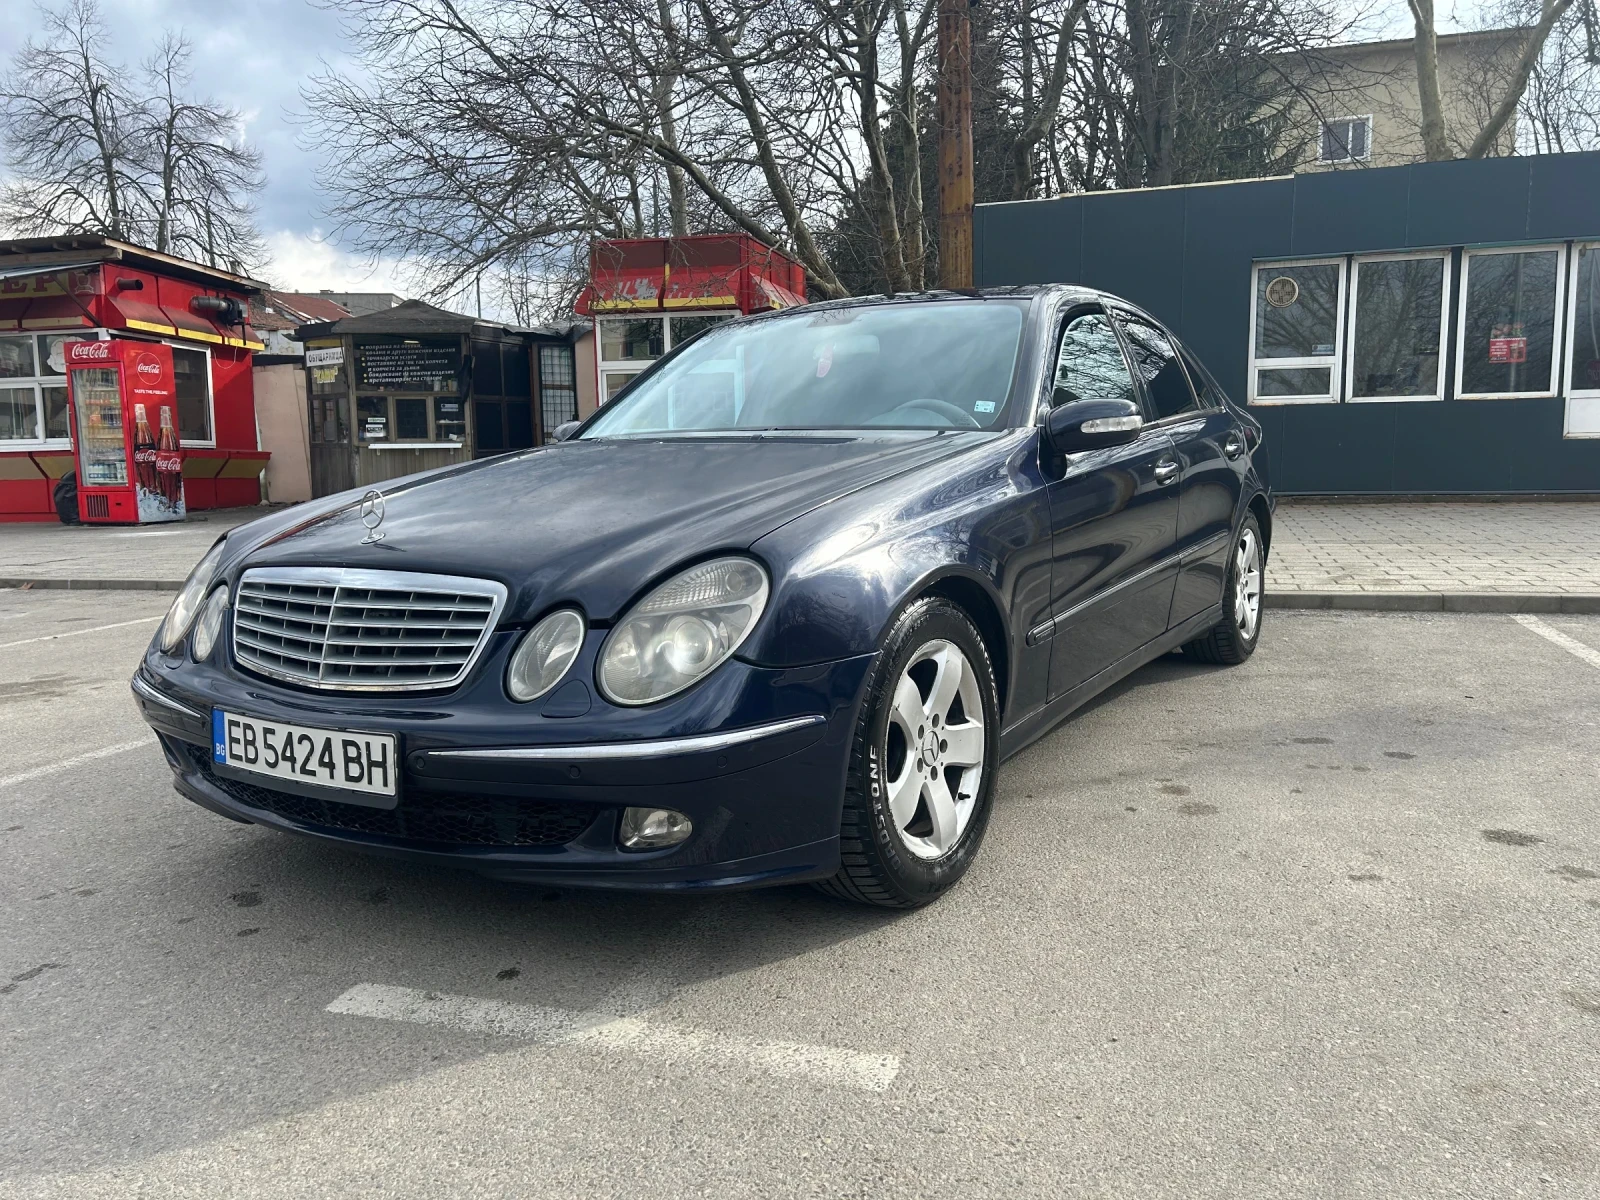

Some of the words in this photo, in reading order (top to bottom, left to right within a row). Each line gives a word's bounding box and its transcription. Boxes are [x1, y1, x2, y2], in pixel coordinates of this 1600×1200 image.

[72, 342, 110, 359] Coca-Cola
[308, 350, 343, 363] ОБУЩАРНИЦА
[215, 743, 226, 756] BG
